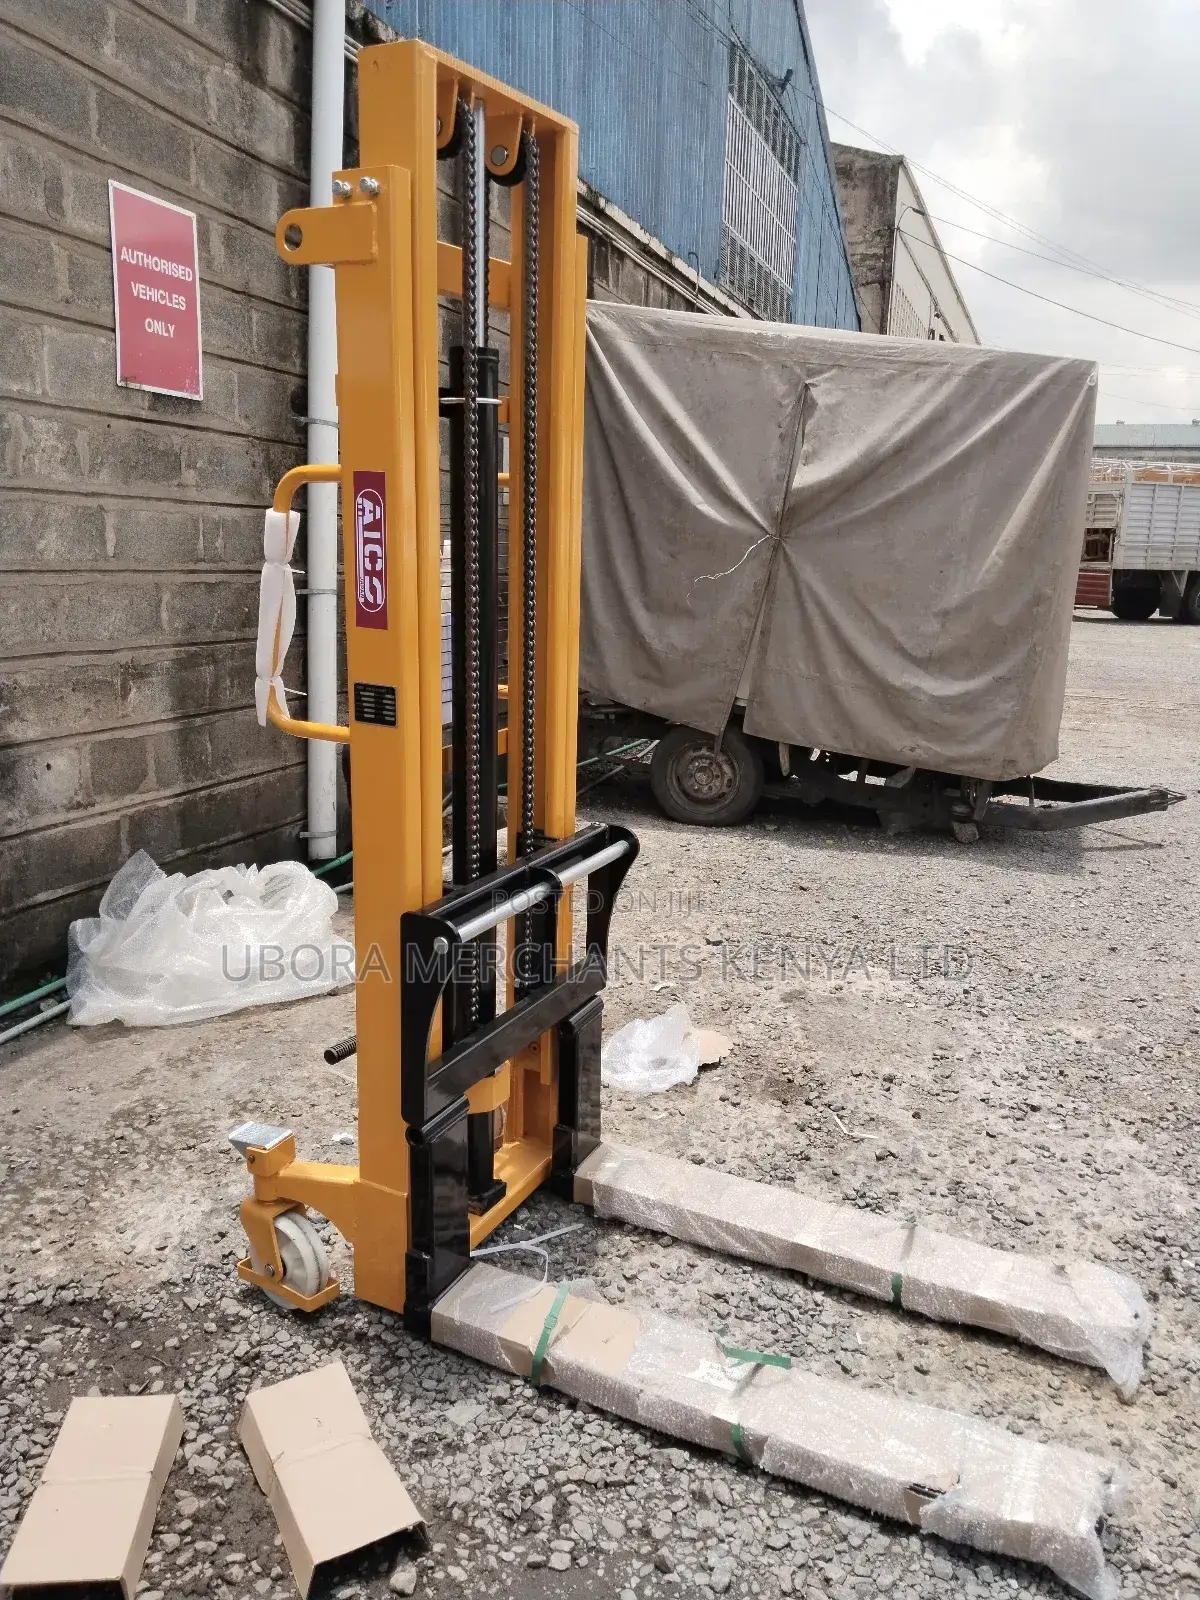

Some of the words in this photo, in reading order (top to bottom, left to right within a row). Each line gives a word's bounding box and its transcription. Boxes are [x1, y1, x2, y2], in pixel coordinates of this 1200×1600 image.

[120, 246, 193, 282] AUTHORISED
[131, 281, 187, 311] VEHICLES
[145, 317, 176, 338] ONLY
[362, 496, 384, 605] AICS
